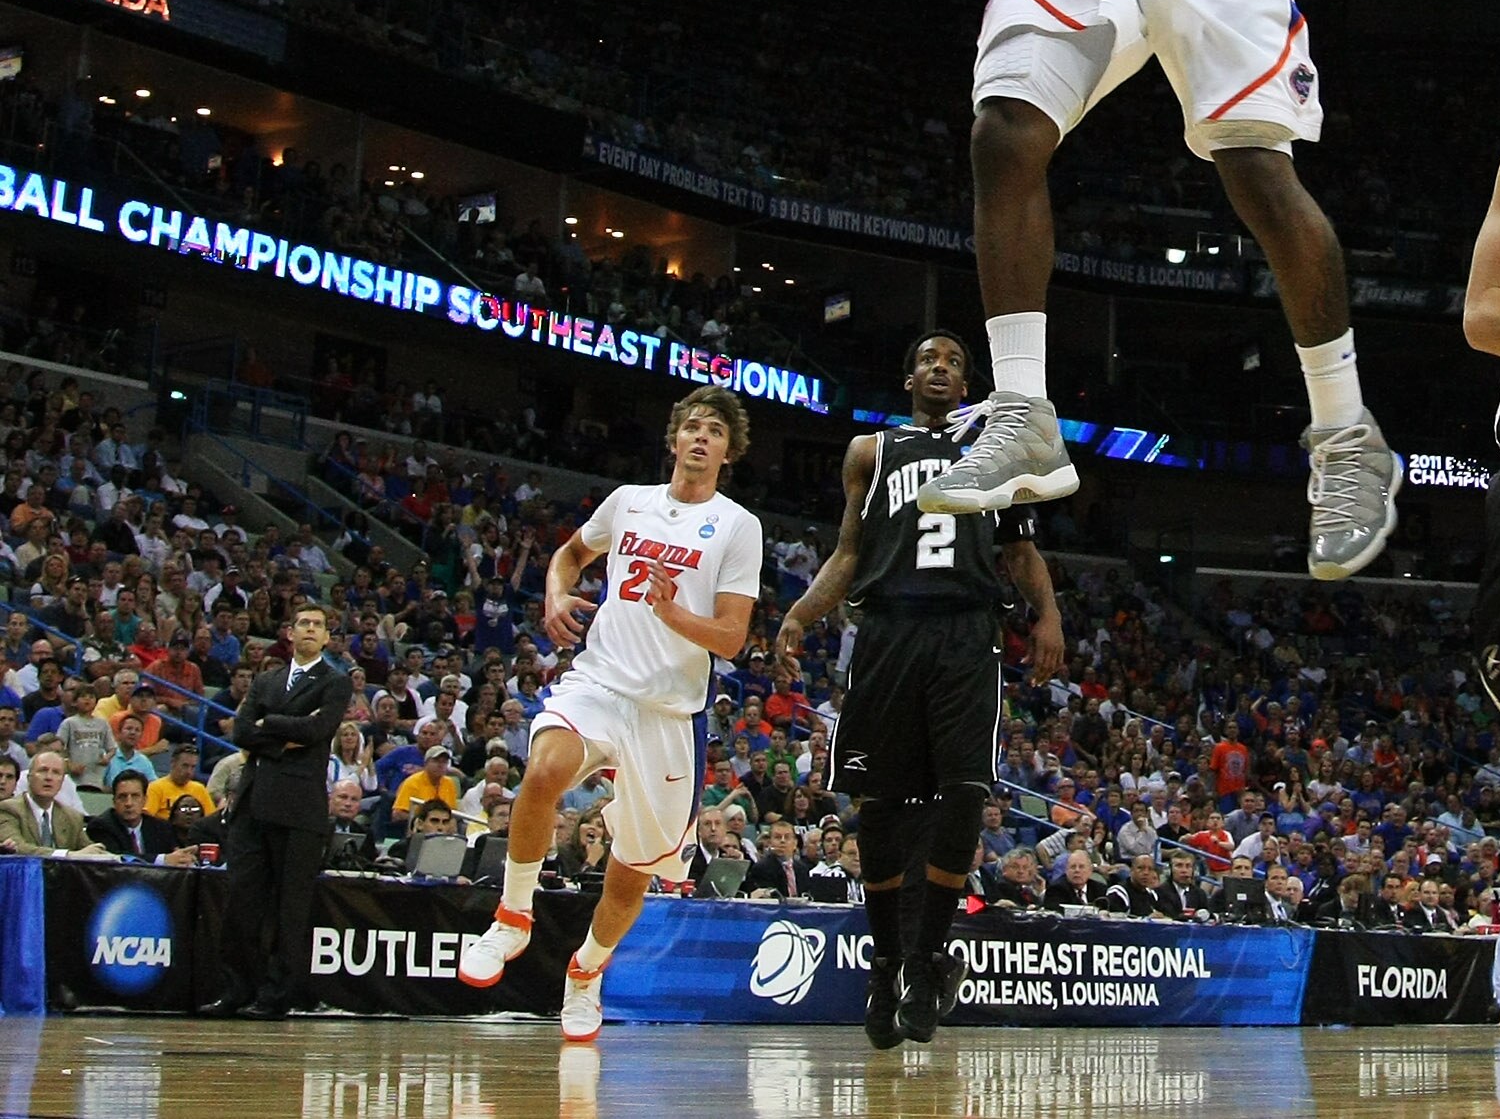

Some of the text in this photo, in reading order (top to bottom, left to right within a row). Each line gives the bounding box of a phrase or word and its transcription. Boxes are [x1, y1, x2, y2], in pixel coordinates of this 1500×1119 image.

[599, 141, 637, 173] EVENT
[638, 154, 661, 182] DAY
[662, 162, 720, 199] PROBLEMS
[721, 182, 748, 208] TEXT
[751, 192, 764, 213] TO
[827, 208, 861, 233] WITH
[864, 214, 925, 244] KEYWORD
[927, 227, 961, 251] NOLA
[1082, 257, 1099, 276] BY
[1100, 259, 1135, 282] ISSUE
[1150, 266, 1216, 291] LOCATION
[118, 199, 441, 312] CHAMPIONSHIP
[447, 283, 661, 370] SOUTHEAST
[669, 341, 830, 415] REGIONAL
[1409, 453, 1442, 470] 2011
[618, 530, 705, 571] FLORIDA
[915, 513, 957, 570] 2
[92, 935, 171, 968] NCAA
[943, 938, 1086, 977] OUTHEAST
[1092, 944, 1211, 979] REGIONAL
[958, 978, 1160, 1011] ORLEANS, LOUISIANA
[1358, 964, 1448, 1000] FLORIDA
